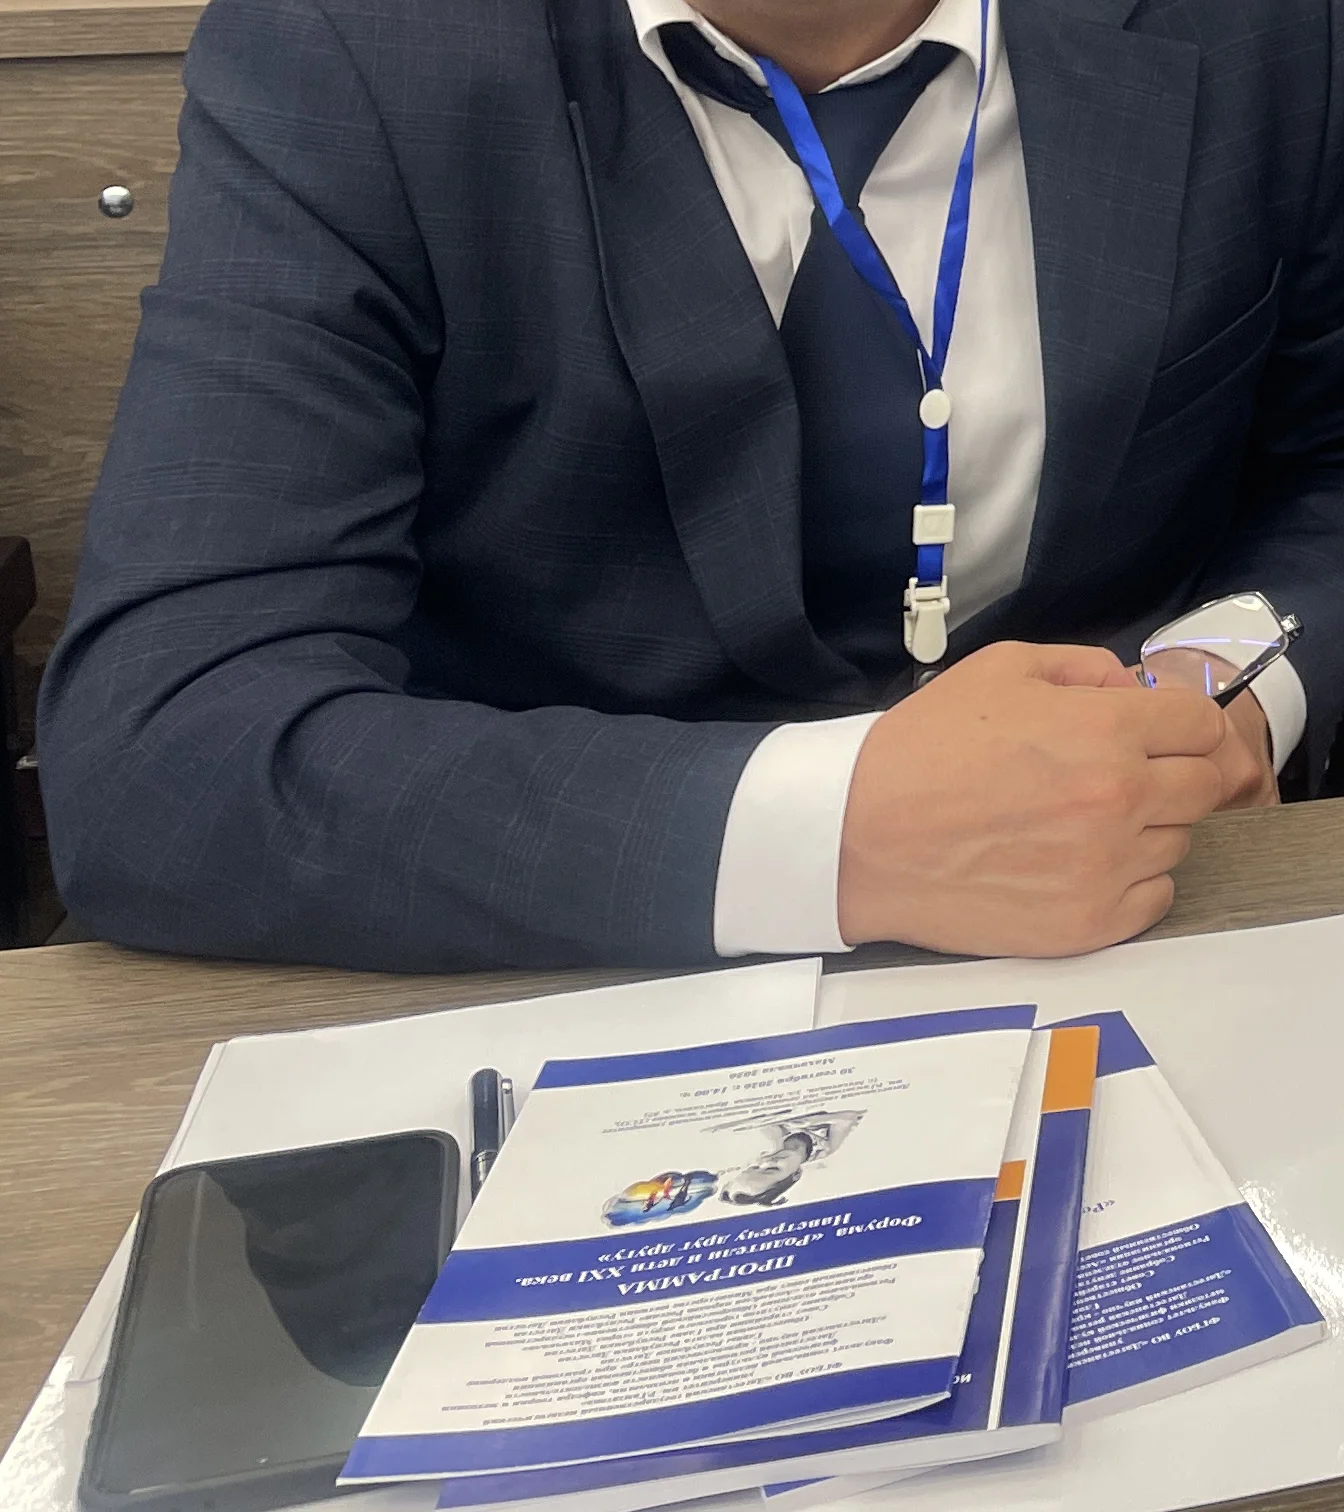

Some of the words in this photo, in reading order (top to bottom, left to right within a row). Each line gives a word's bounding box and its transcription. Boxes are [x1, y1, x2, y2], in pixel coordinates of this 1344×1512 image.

[734, 1212, 852, 1243] Навстречу
[836, 1214, 923, 1239] Форума
[598, 1241, 676, 1264] другу»
[678, 1233, 732, 1252] друг
[708, 1232, 824, 1261] «Родители
[577, 1265, 626, 1283] XXI
[617, 1255, 795, 1297] ПРОГРАММА
[631, 1256, 684, 1275] дети
[516, 1272, 574, 1288] века.
[1175, 1315, 1221, 1339] ФГБОУ
